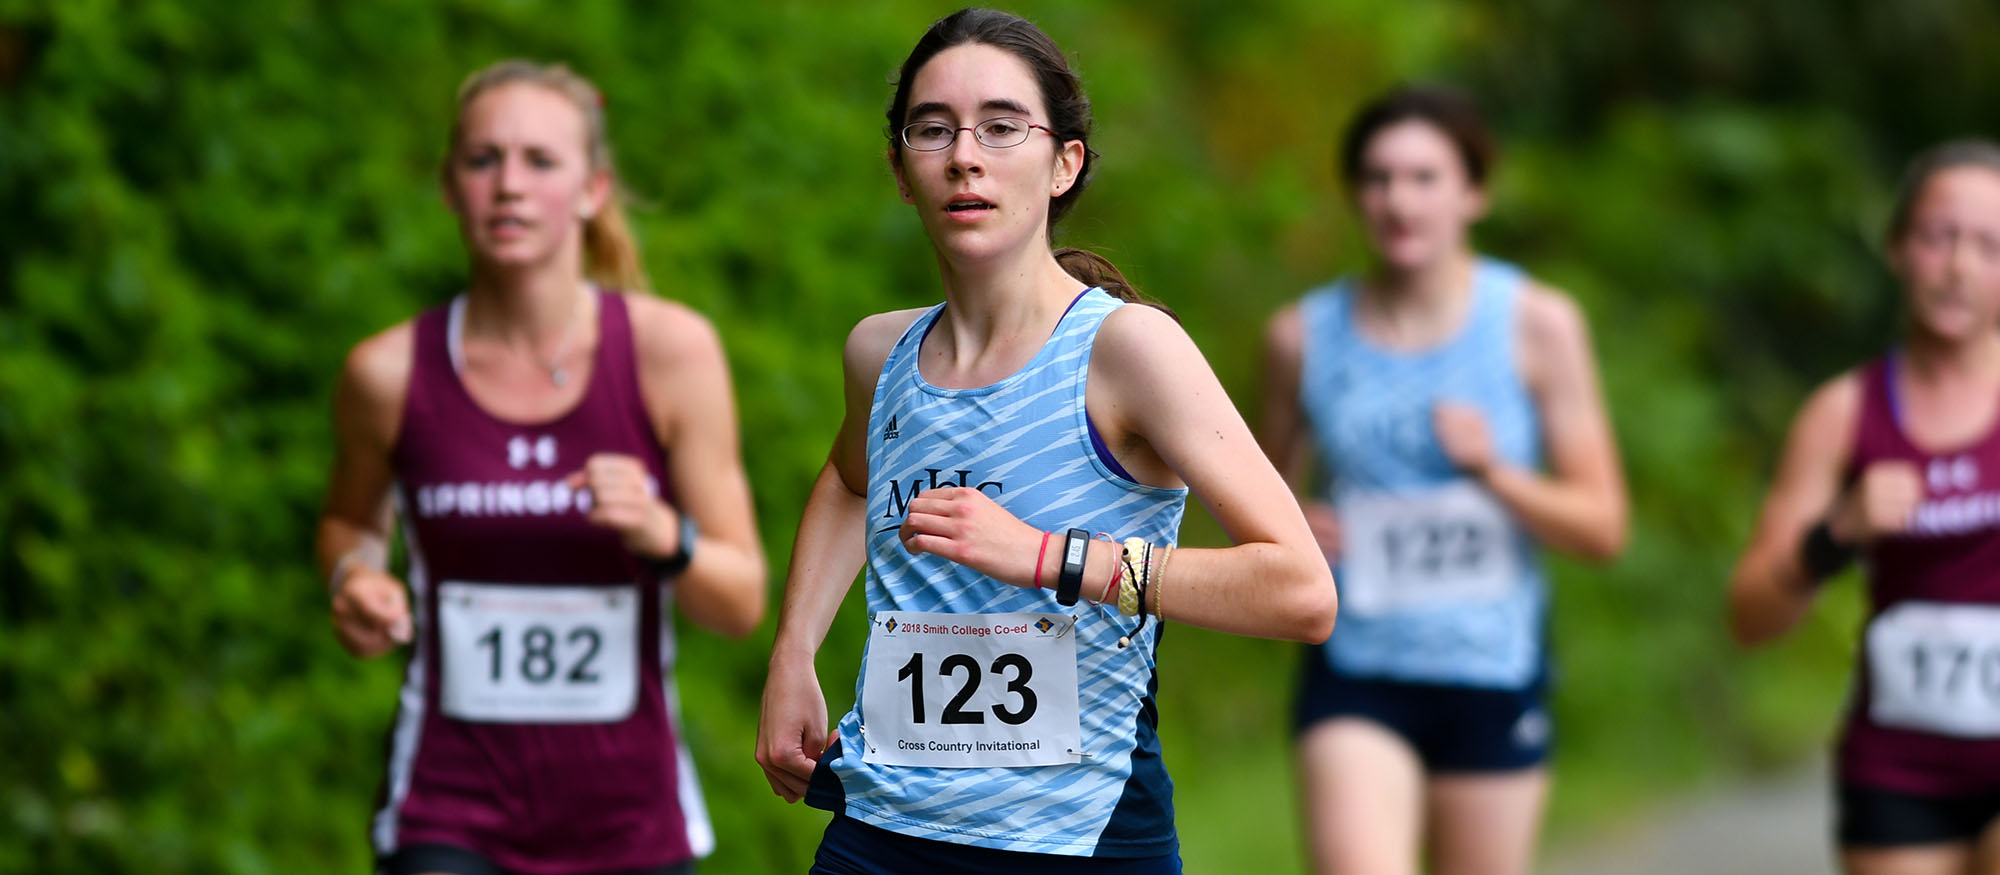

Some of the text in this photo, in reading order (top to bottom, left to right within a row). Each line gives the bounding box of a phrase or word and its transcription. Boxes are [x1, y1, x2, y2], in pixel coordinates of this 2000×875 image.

[901, 623, 1028, 637] 2018 Smith College Co-ed
[475, 625, 604, 685] 182
[898, 652, 1038, 725] 123
[898, 739, 1040, 753] Cross Country Invitational
